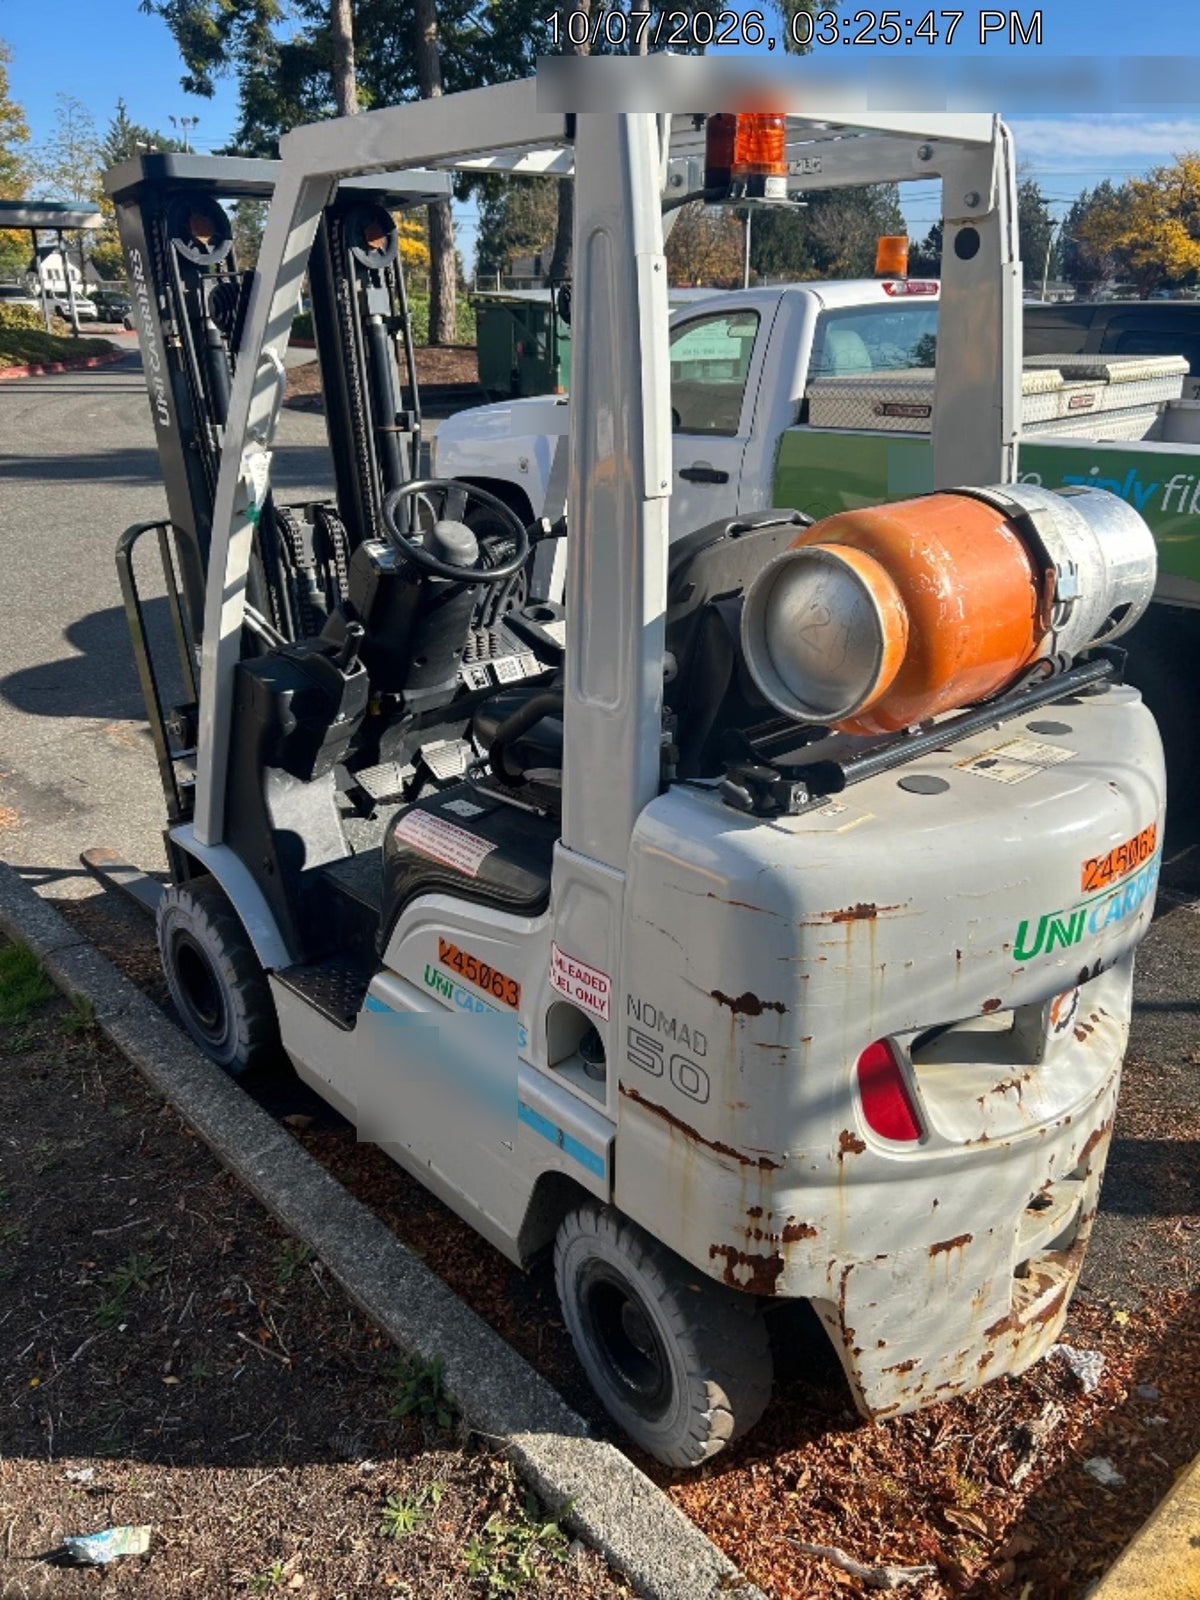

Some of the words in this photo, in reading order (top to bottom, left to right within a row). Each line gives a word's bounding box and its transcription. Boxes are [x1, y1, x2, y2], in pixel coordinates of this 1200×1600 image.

[439, 936, 519, 1007] 245063
[576, 987, 606, 1012] ONLY
[627, 994, 707, 1056] NOMAD
[627, 1027, 710, 1104] 50
